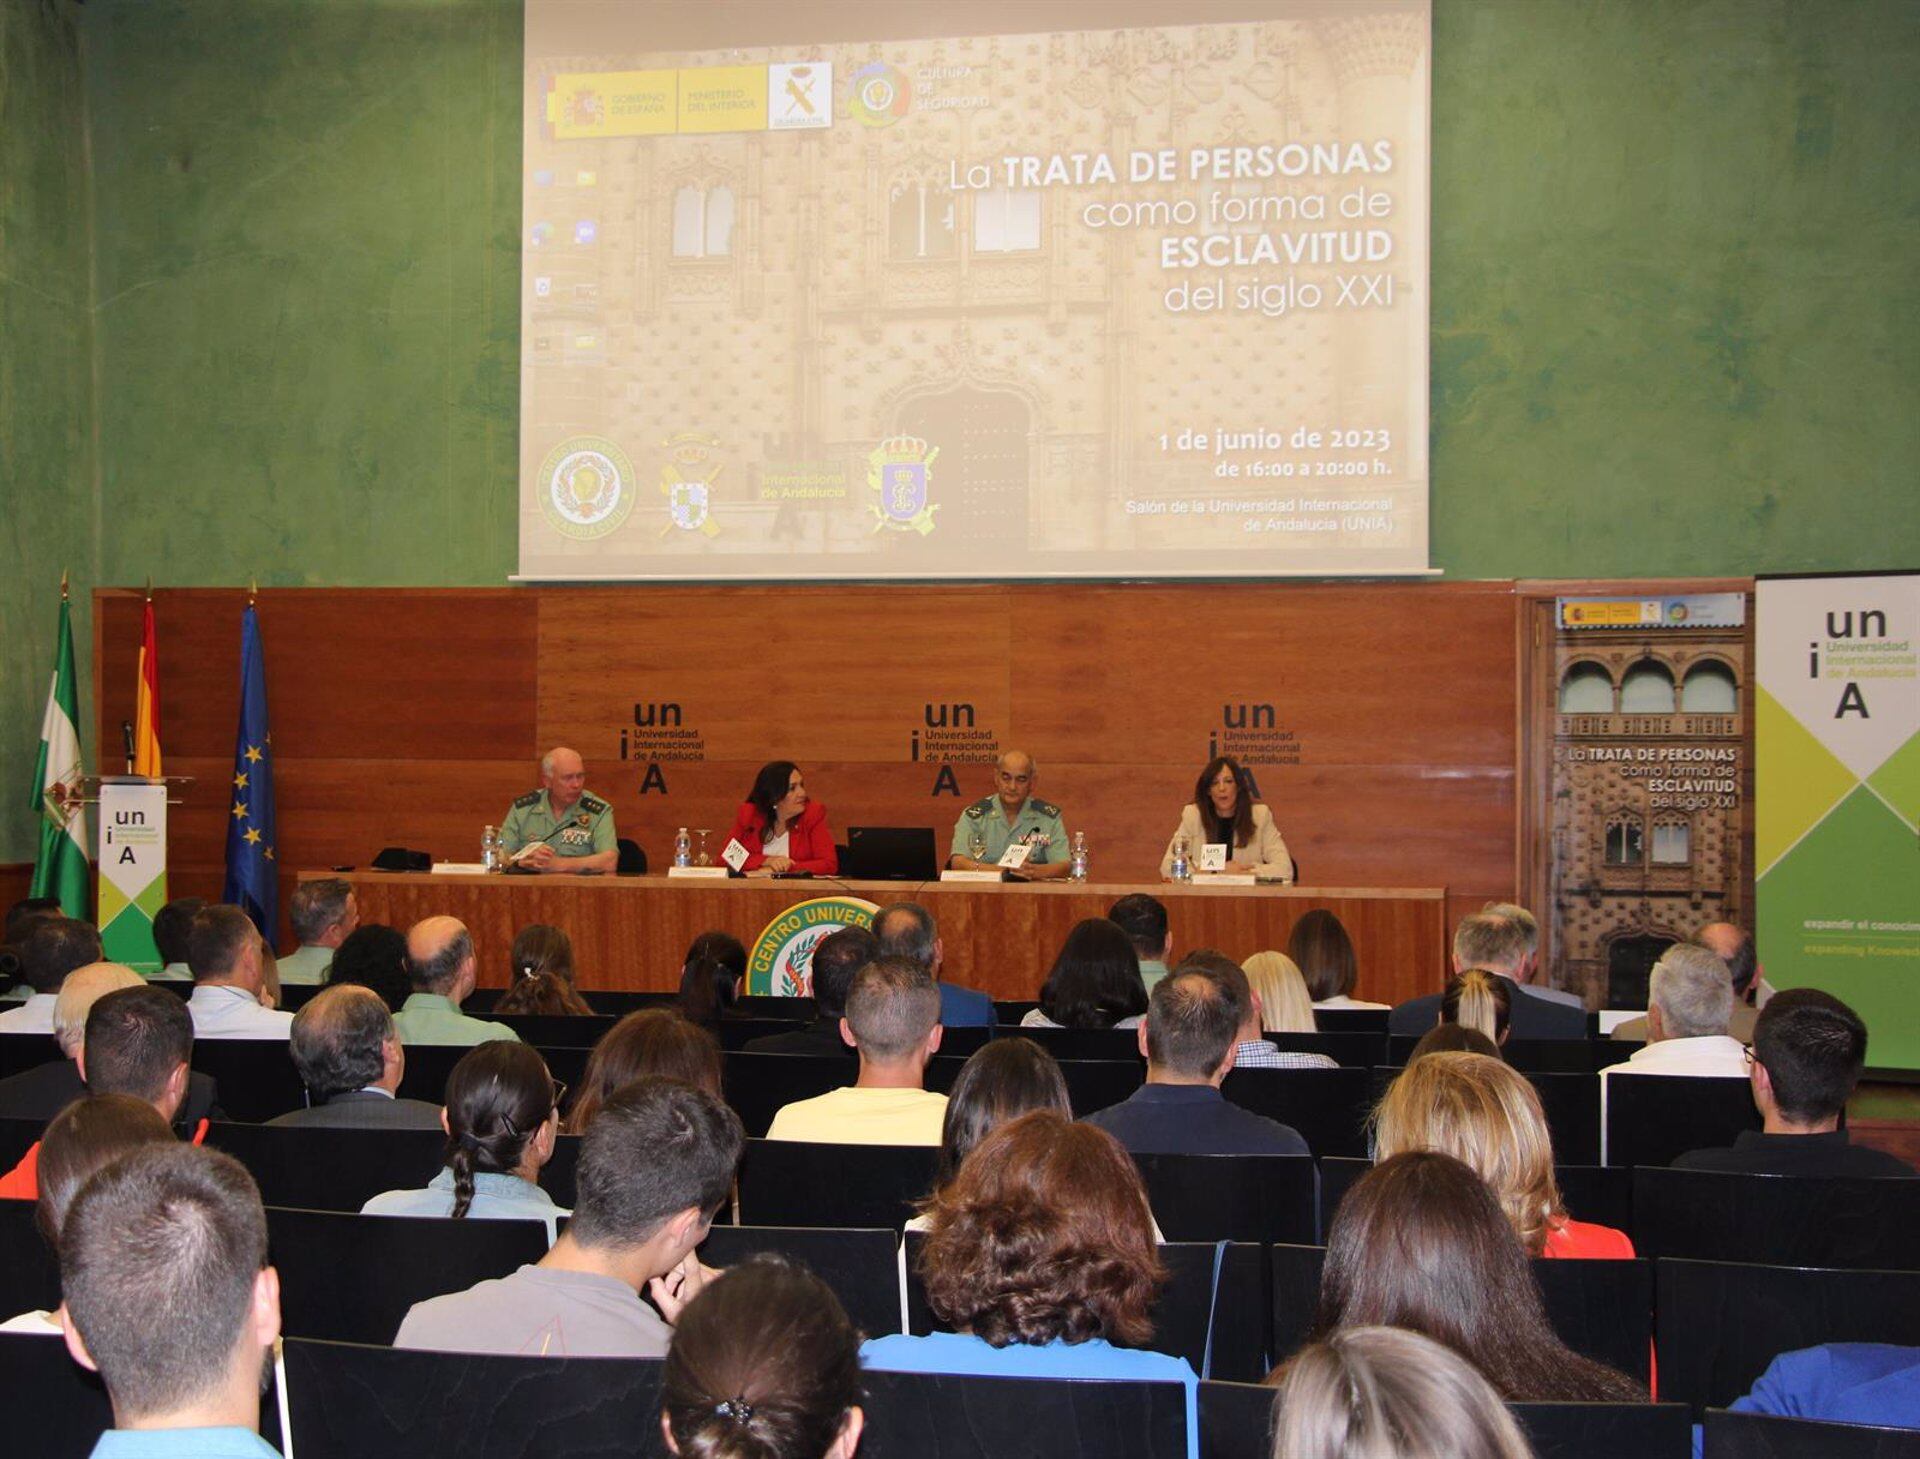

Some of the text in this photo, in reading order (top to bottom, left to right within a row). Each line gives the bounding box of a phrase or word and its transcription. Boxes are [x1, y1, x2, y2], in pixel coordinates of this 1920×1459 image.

[950, 140, 1393, 190] La TRATA DE PERSONAS
[1083, 185, 1393, 228] como forma de
[1160, 230, 1393, 269] ESCLAVITUD
[1164, 274, 1393, 317] del siglo XXI
[1159, 427, 1391, 455] 1 de junio de 2023
[1214, 458, 1393, 477] de 16:00 a 20:00 h.
[1125, 497, 1393, 515] Salón de la Universidad Internacional
[1243, 518, 1261, 532] de
[1342, 516, 1393, 533] (UNIA)
[1826, 609, 1887, 639] un
[1826, 640, 1910, 653] Universidad
[1809, 642, 1819, 679] i
[1826, 653, 1918, 666] Internacional
[1833, 682, 1871, 720] A
[634, 702, 682, 727] un
[924, 703, 975, 728] un
[1223, 703, 1276, 729] un
[634, 729, 699, 740] Universidad
[925, 730, 993, 740] Universidad
[1223, 731, 1294, 742] Universidad
[634, 739, 705, 750] Internacional
[925, 741, 999, 751] Internacional
[1223, 743, 1301, 753] Internacional
[634, 751, 647, 761] de
[925, 751, 939, 762] de
[1568, 748, 1736, 762] La TRATA DE PERSONAS
[639, 763, 668, 795] A
[1620, 764, 1736, 777] como forma de
[931, 764, 962, 797] A
[1648, 779, 1736, 793] ESCLAVITUD
[1650, 795, 1736, 811] del siglo XXI
[115, 811, 145, 825] un
[119, 846, 136, 865] A
[755, 915, 802, 973] CENTRO
